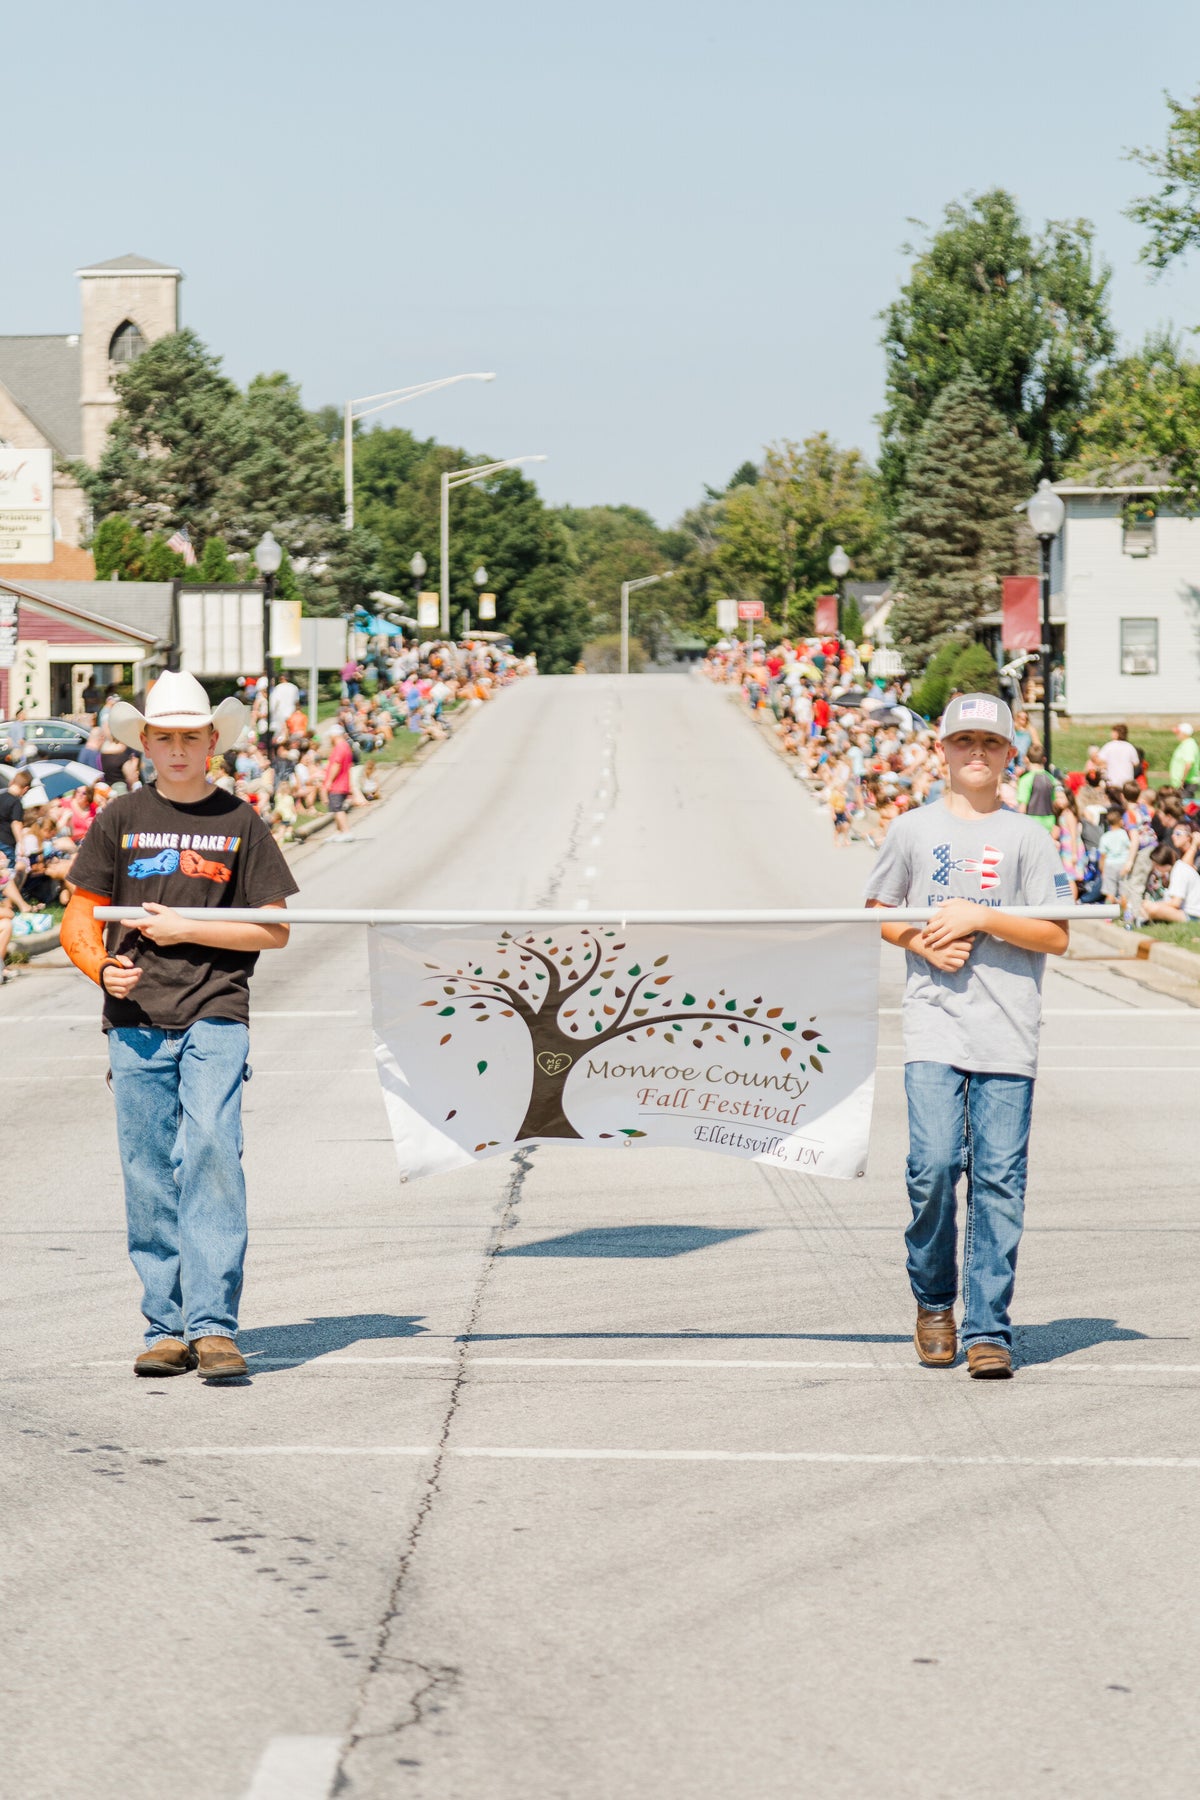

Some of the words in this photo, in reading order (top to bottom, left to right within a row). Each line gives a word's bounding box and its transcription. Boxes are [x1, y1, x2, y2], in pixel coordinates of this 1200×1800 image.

[138, 833, 180, 849] SHAKE
[180, 834, 192, 849] N
[191, 834, 227, 851] BAKE
[927, 894, 1002, 907] FROM
[586, 1059, 700, 1082] Monroe
[705, 1064, 809, 1100] County
[636, 1087, 695, 1109] Fall
[698, 1092, 807, 1126] Festival
[693, 1125, 789, 1162] Ellettsville,
[795, 1146, 825, 1166] IN
